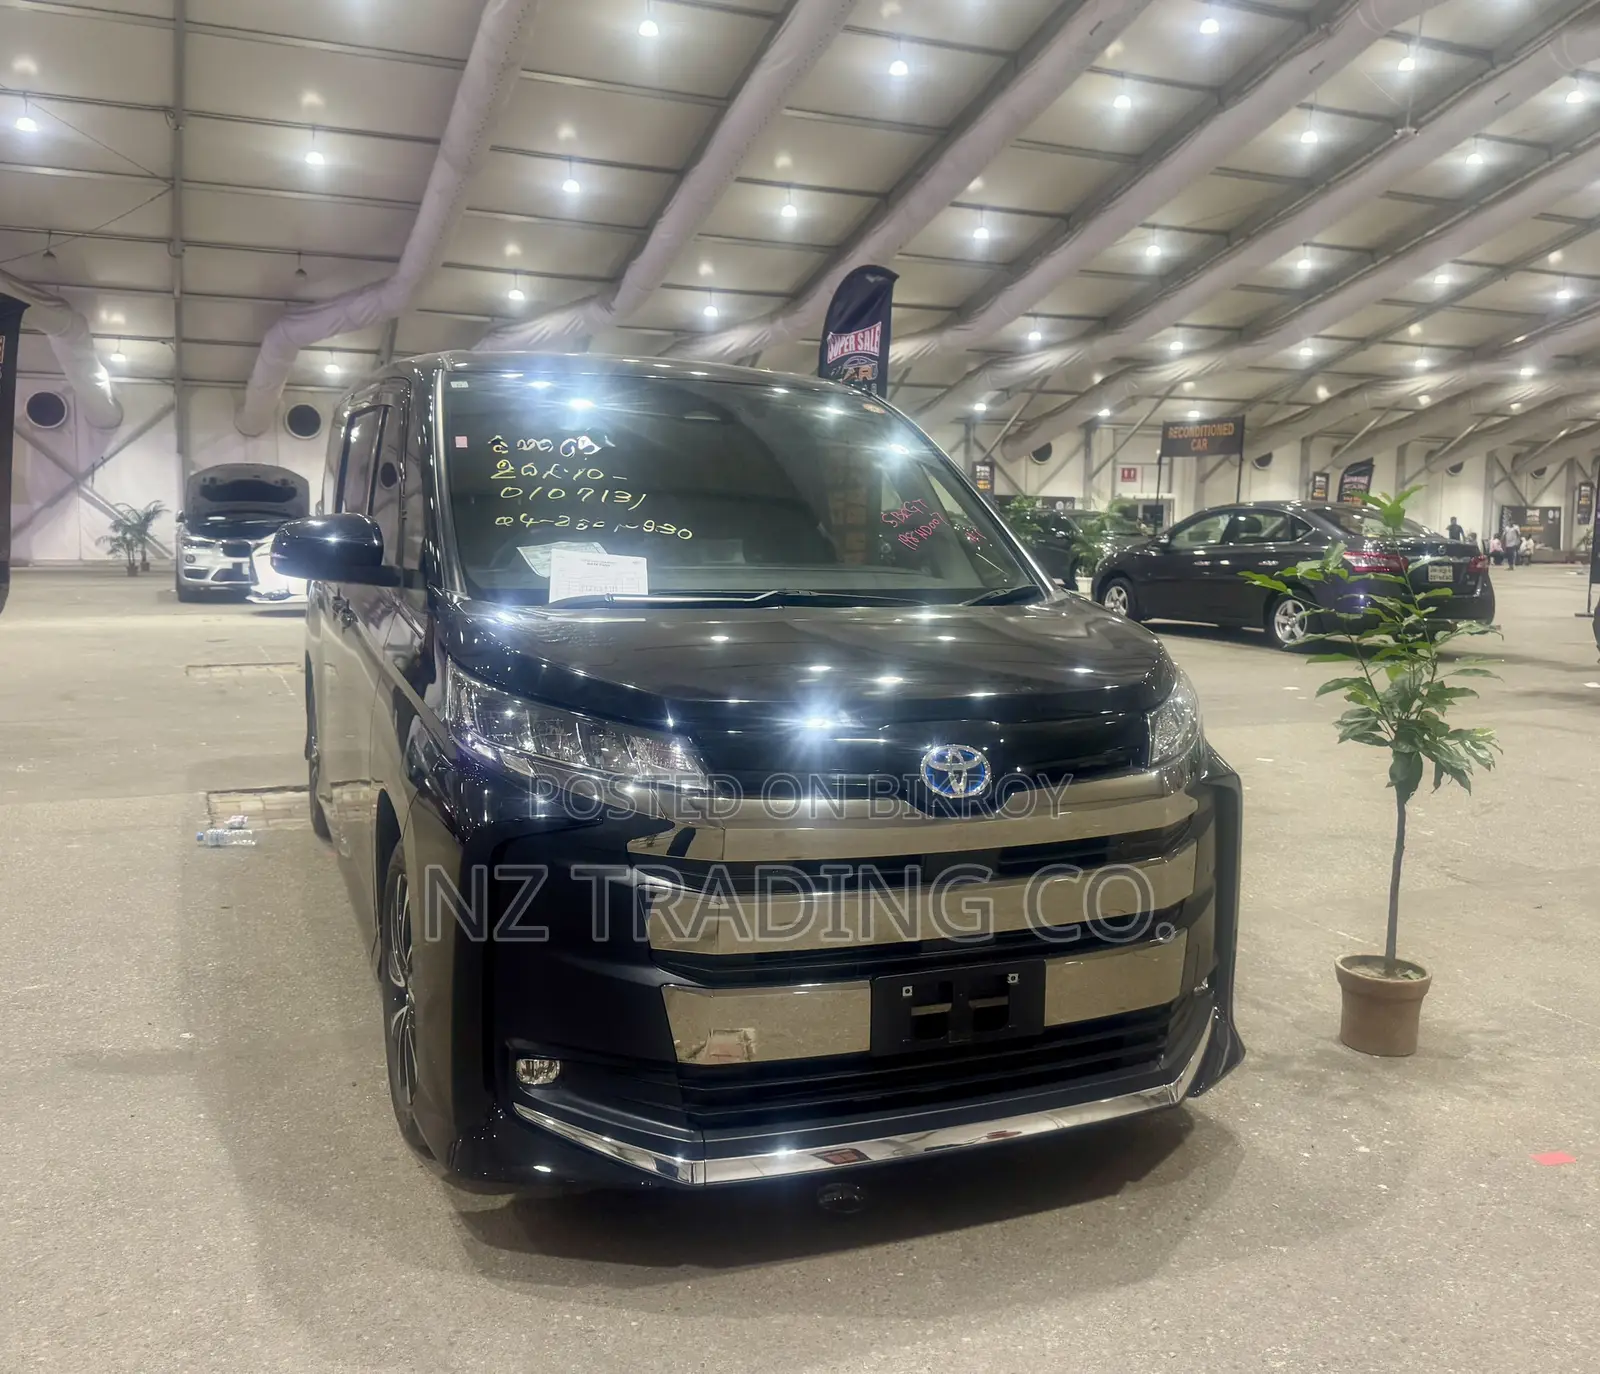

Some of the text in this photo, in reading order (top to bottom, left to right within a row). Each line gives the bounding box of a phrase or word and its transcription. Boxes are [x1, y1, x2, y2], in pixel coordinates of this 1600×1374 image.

[857, 325, 881, 354] SALE
[1168, 422, 1235, 438] RECONDITIONED
[1191, 438, 1208, 451] CAR
